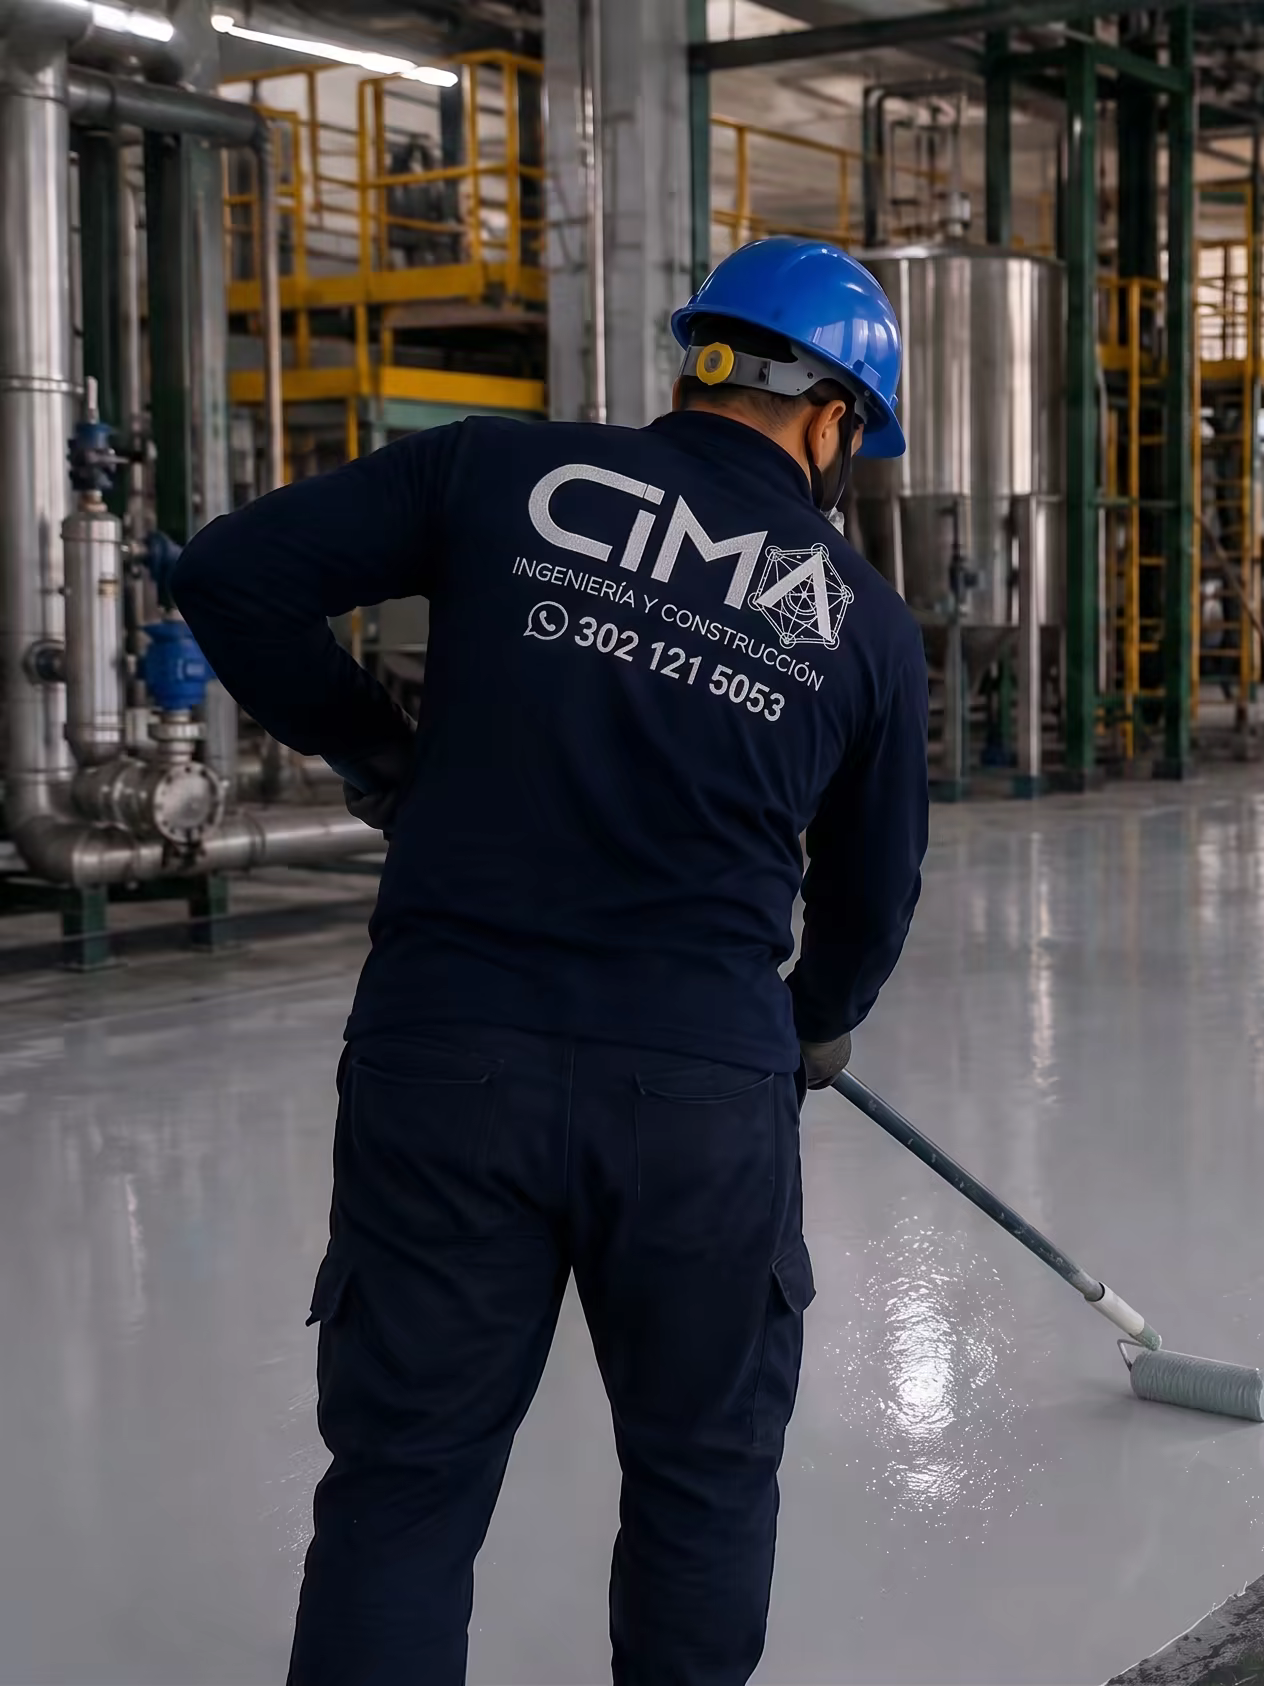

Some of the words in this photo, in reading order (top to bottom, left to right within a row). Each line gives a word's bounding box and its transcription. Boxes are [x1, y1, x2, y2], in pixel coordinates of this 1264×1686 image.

[512, 556, 636, 608] INGENIERÍA
[643, 594, 659, 614] Y
[661, 603, 825, 692] CONSTRUCCIÓN
[574, 616, 640, 662] 302
[649, 641, 703, 685] 121
[708, 664, 786, 722] 5053
